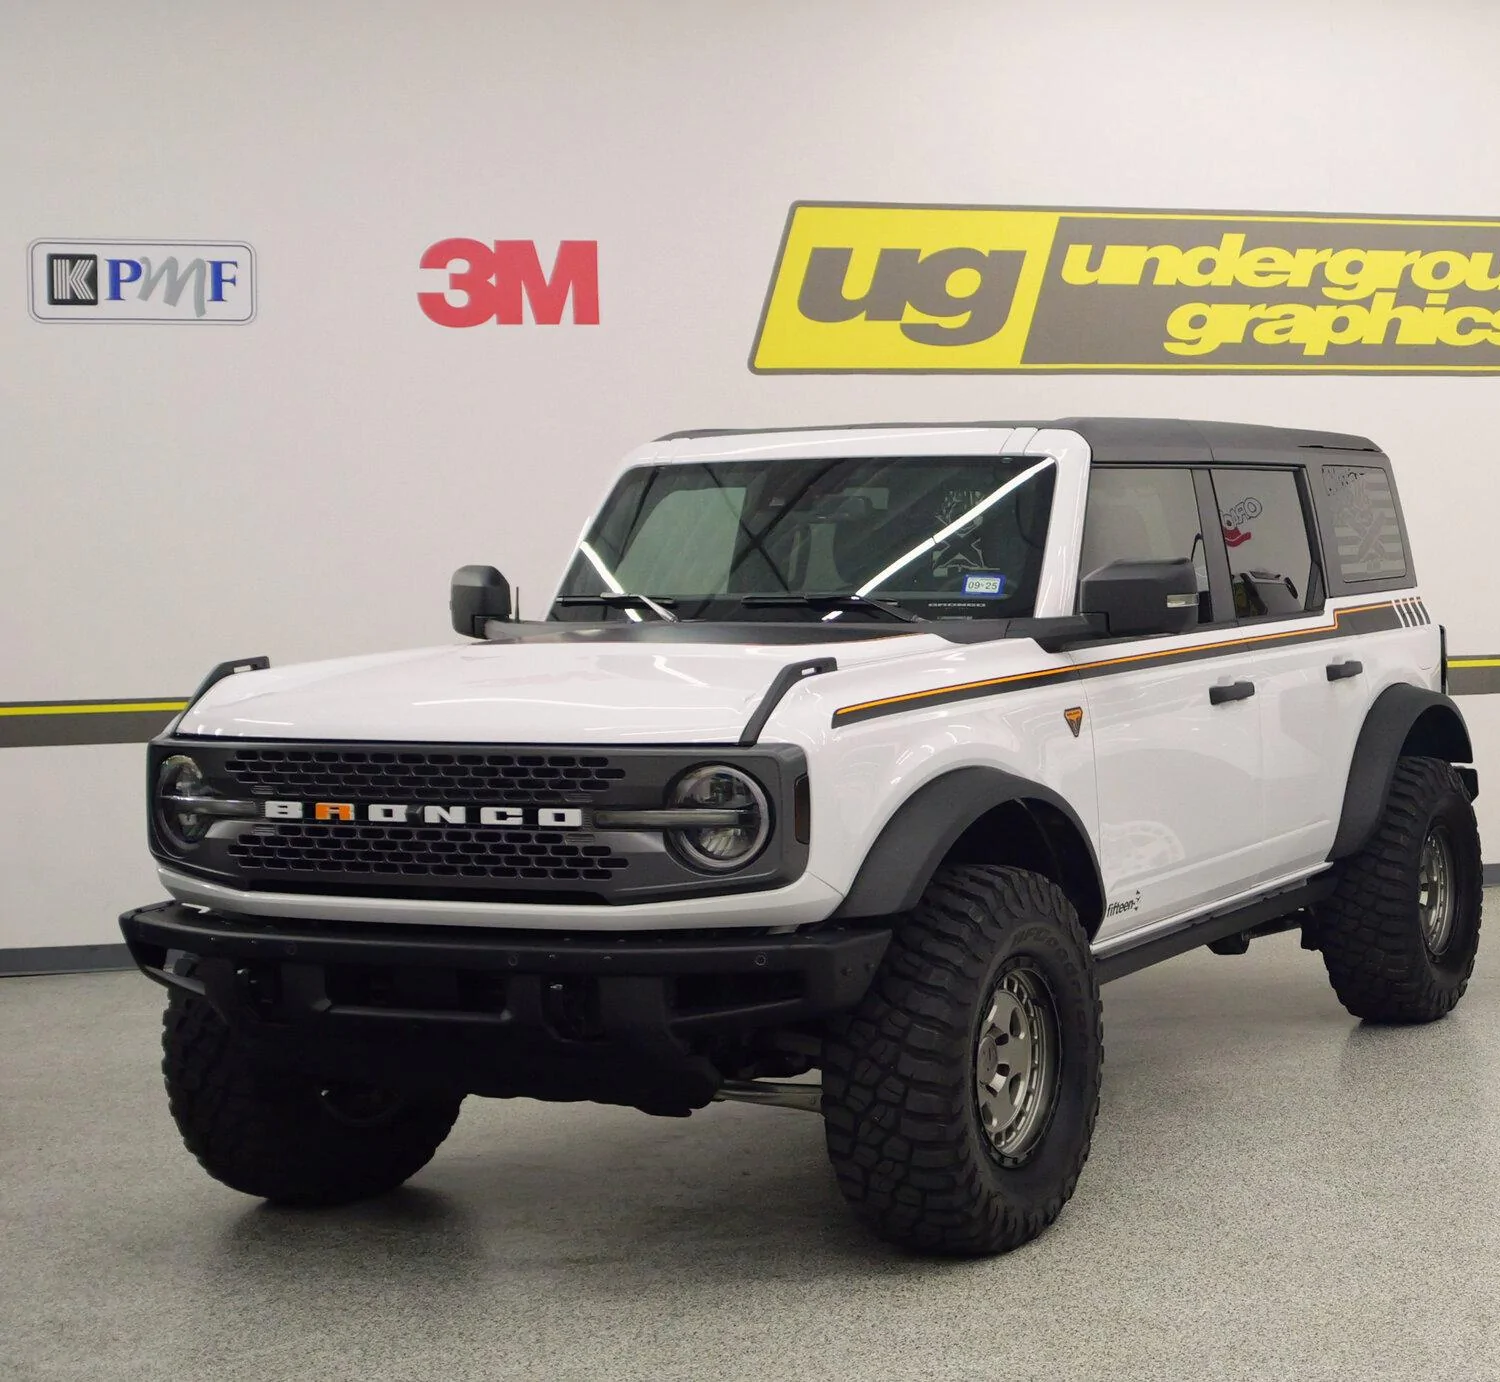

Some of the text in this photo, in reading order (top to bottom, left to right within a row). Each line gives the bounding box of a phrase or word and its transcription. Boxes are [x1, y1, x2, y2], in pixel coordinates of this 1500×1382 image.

[47, 253, 238, 317] KPMF
[417, 237, 600, 328] 3M
[797, 247, 1027, 346] ug
[265, 801, 582, 827] BRONCO
